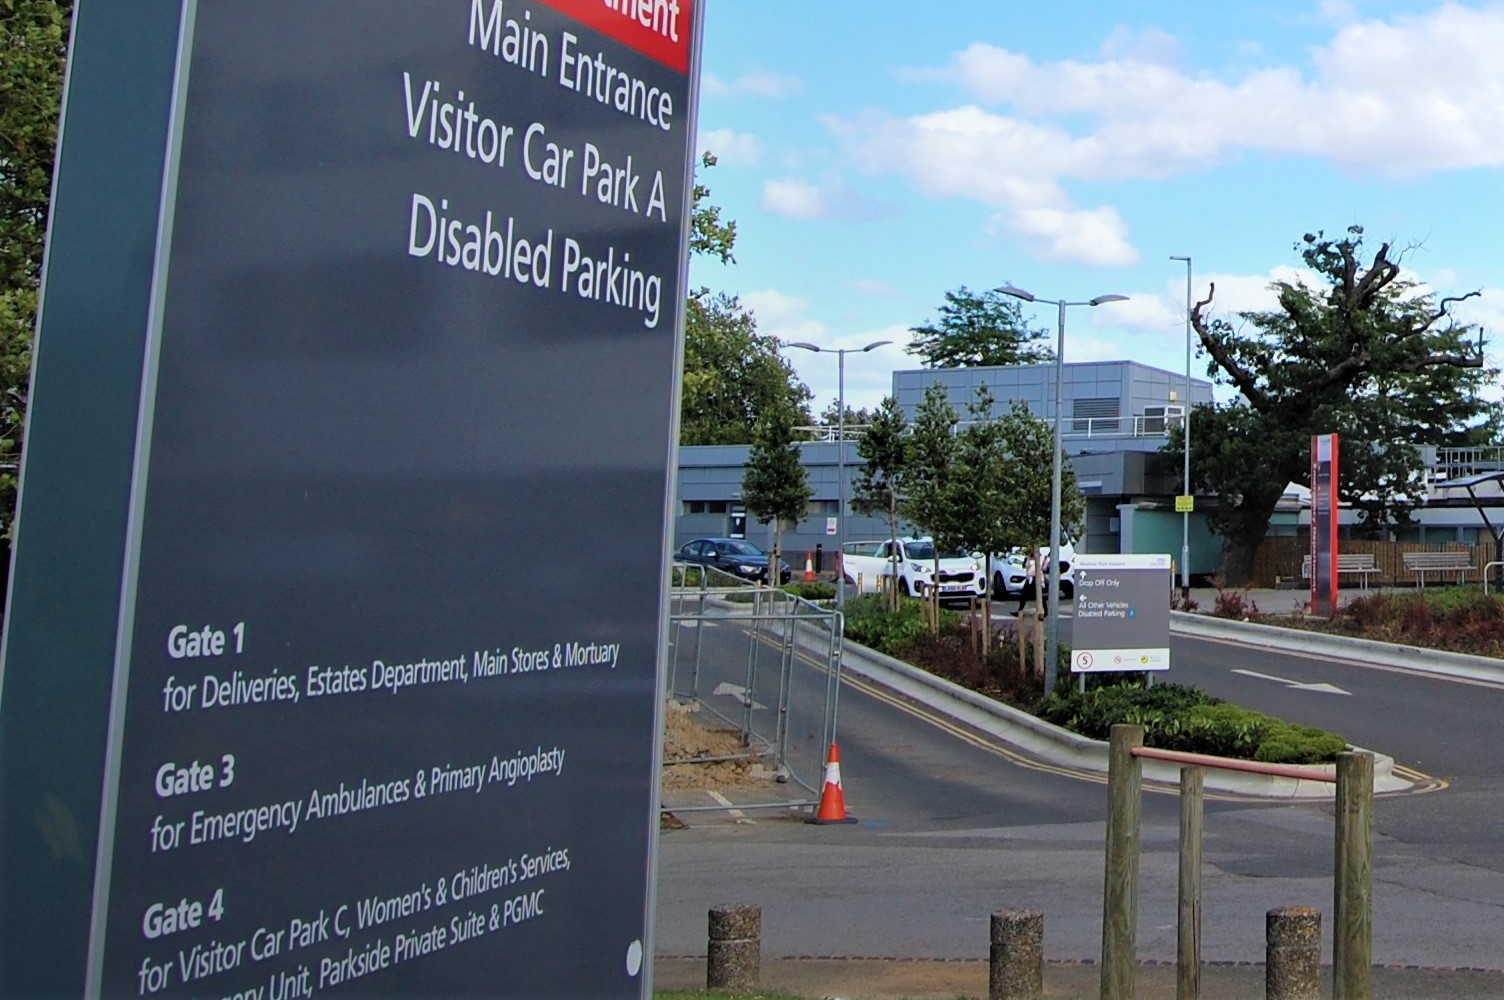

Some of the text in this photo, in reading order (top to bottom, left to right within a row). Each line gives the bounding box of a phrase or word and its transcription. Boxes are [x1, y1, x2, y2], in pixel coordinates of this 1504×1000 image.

[560, 30, 672, 131] Entrance
[403, 71, 666, 223] Visitor Car Park A
[409, 193, 661, 328] Disabled Parking
[168, 622, 245, 659] Gate 1
[1103, 610, 1125, 618] Parking
[163, 641, 619, 712] for Deliveries, Estates Department, Main Stores & Mortuary
[1083, 656, 1088, 665] 5
[151, 746, 565, 852] for Emergency Ambulances & Primary Angioplasty
[155, 754, 235, 797] Gate 3
[138, 846, 570, 995] for Visitor Car Park C, Women's & Children's Services,
[143, 888, 224, 938] Gate 4
[270, 889, 544, 1000] Unit, Parkside Private Suite & PGMC
